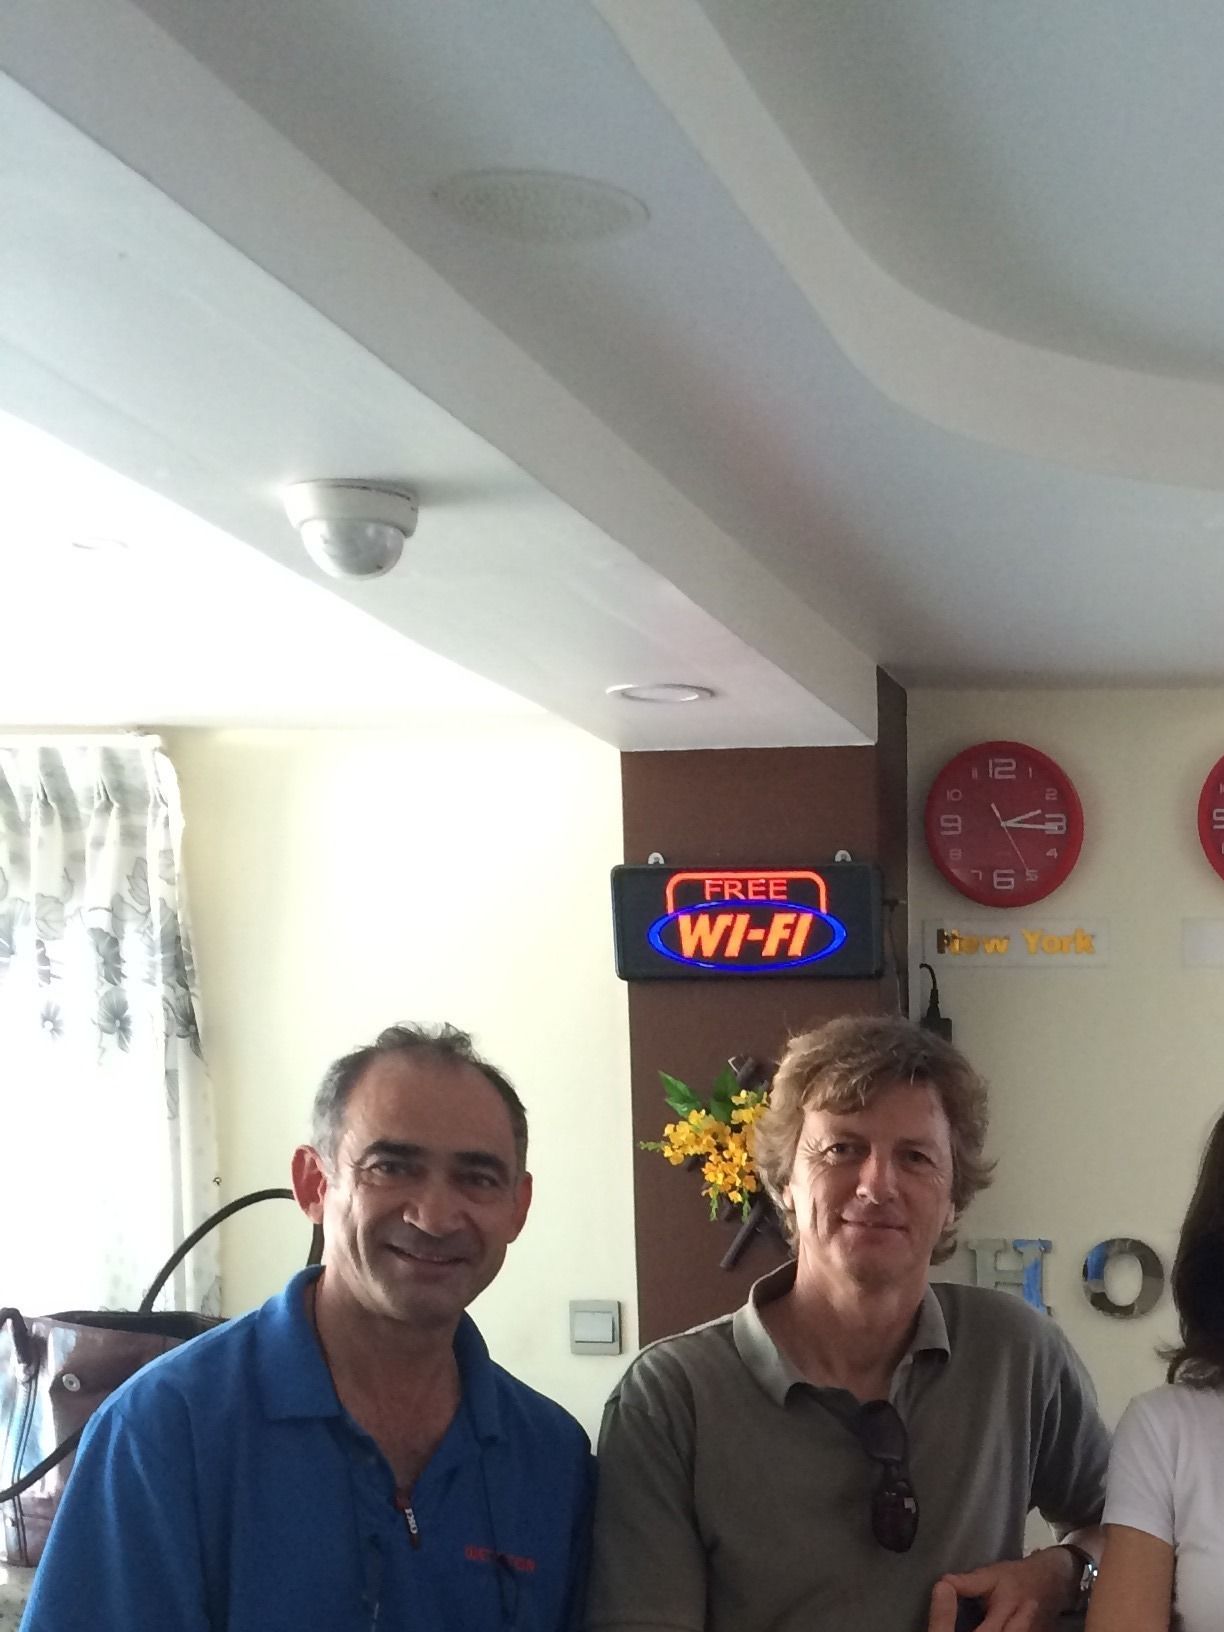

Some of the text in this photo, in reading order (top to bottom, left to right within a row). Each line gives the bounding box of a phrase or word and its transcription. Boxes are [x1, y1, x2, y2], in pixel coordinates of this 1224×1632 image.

[989, 758, 1016, 779] 12
[940, 815, 962, 836] 9
[993, 869, 1015, 889] 6
[705, 879, 788, 901] FREE
[677, 913, 813, 957] WI-FI
[936, 927, 1096, 955] New York
